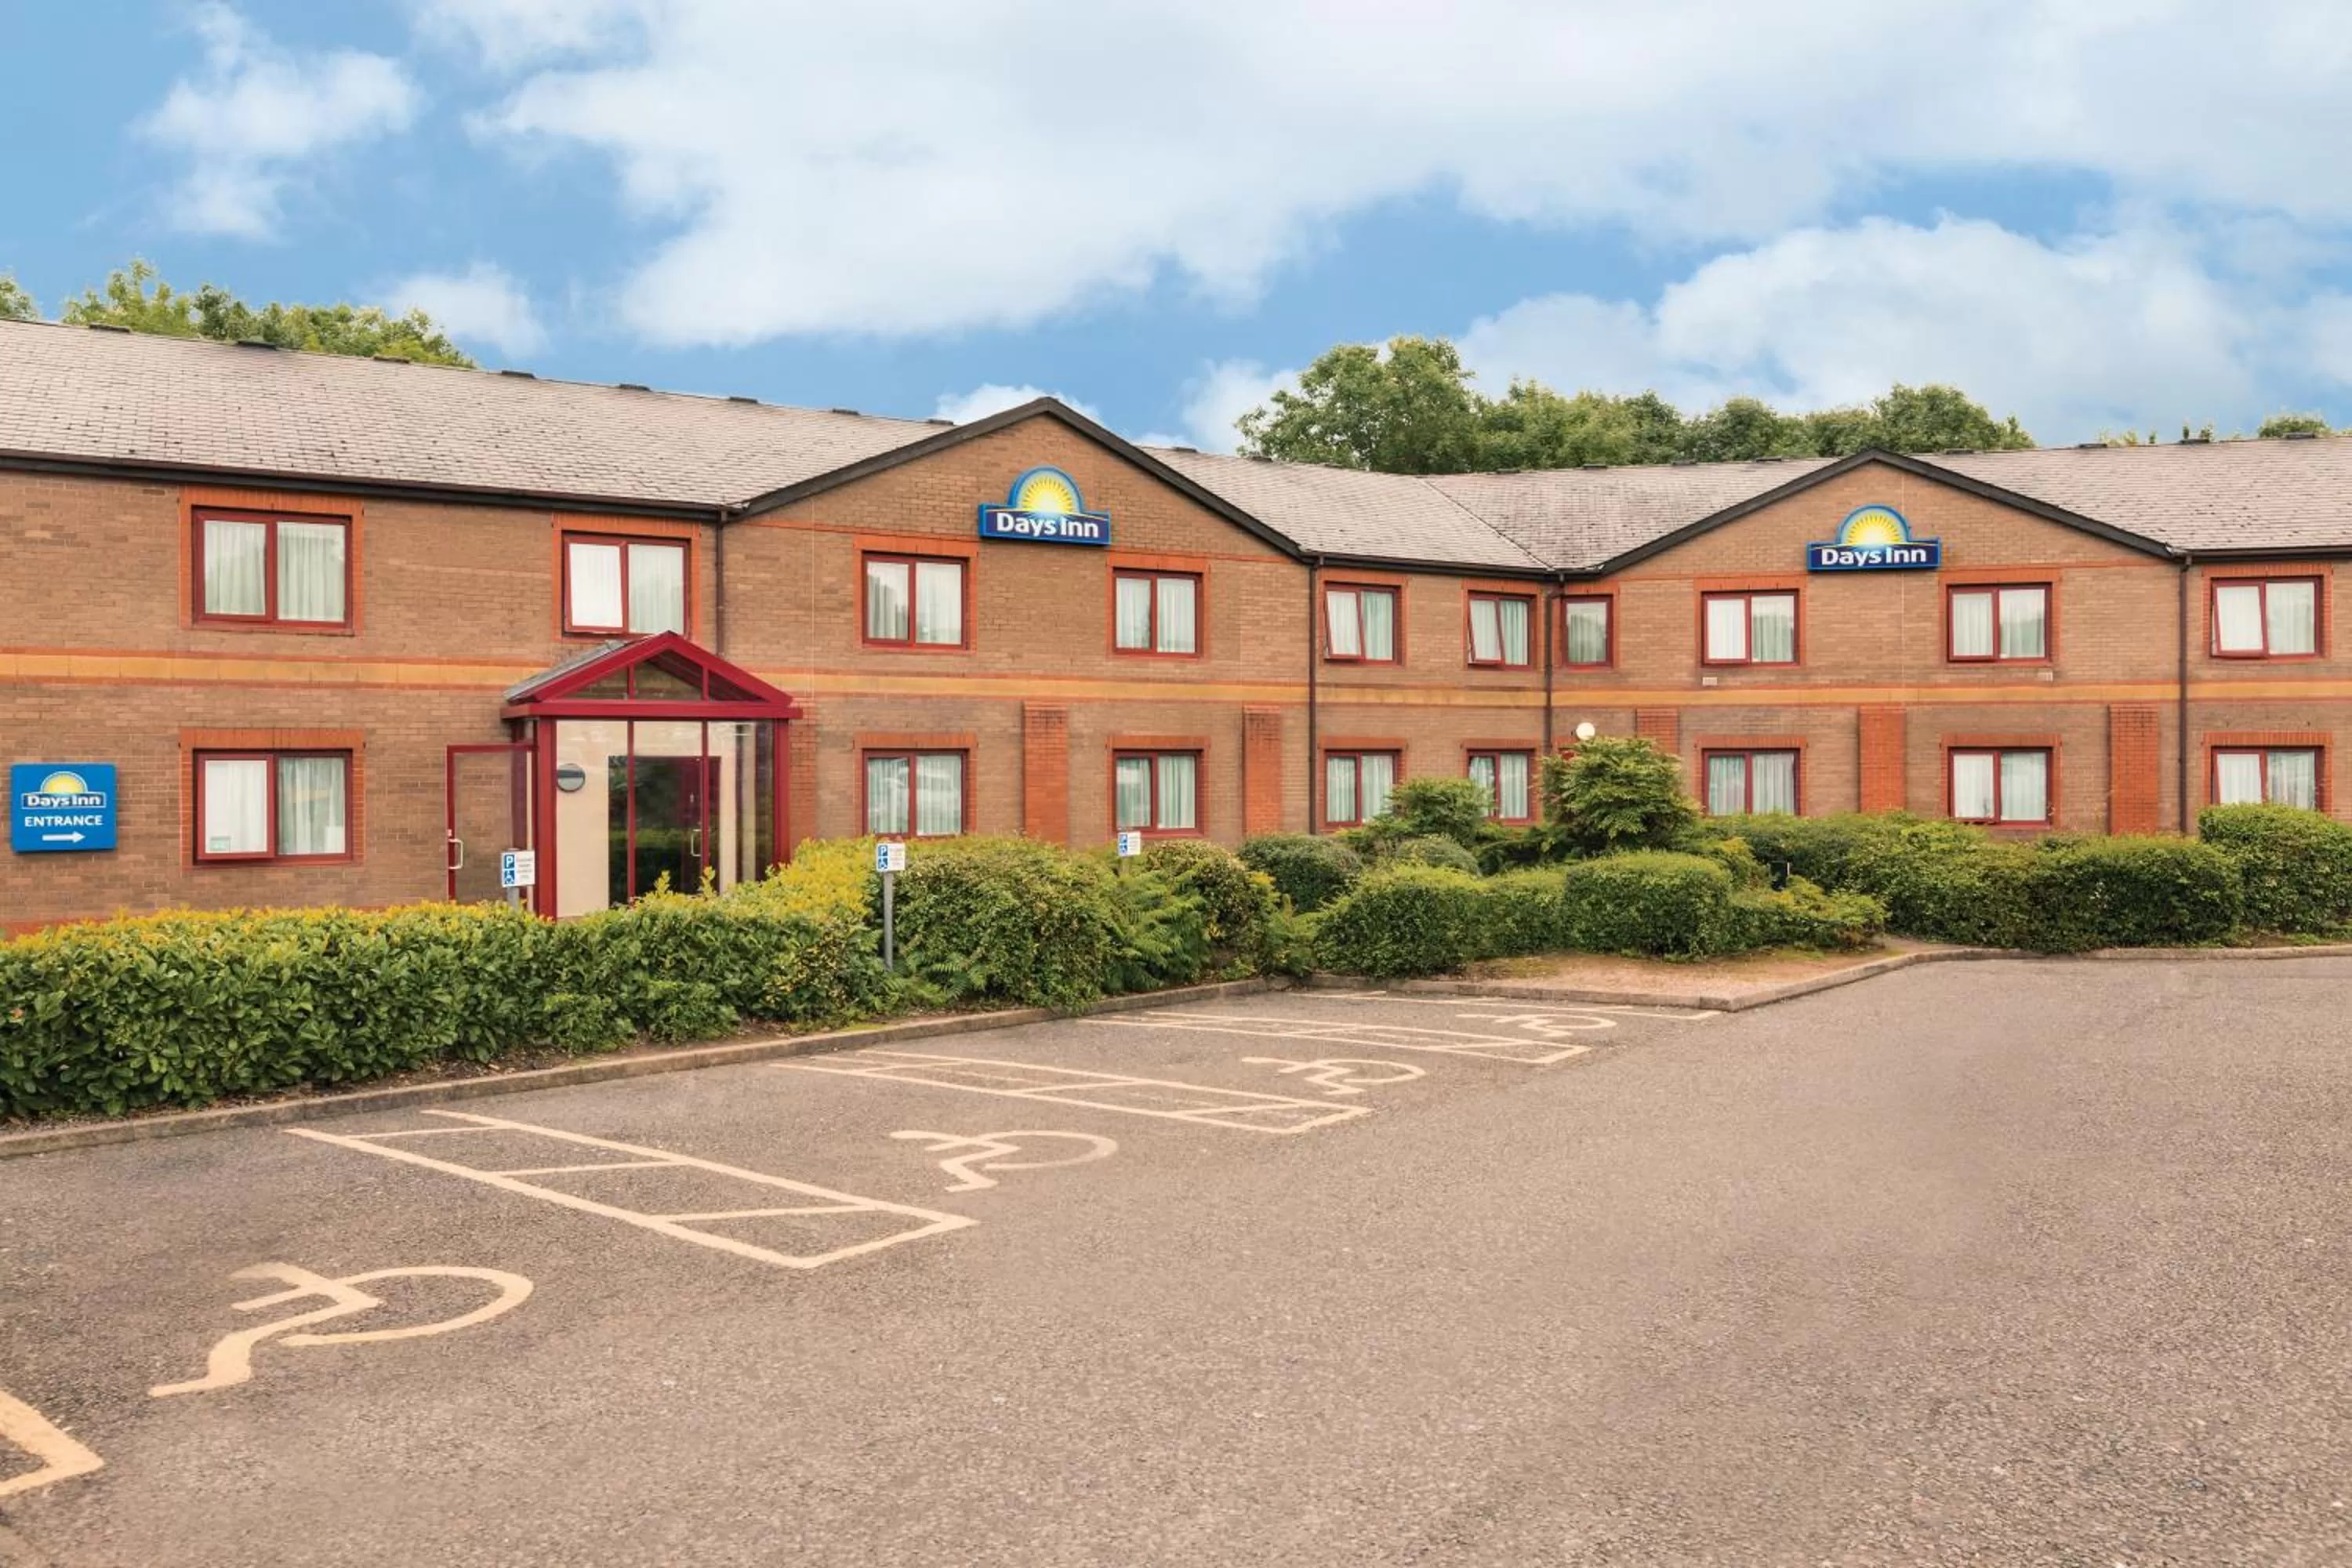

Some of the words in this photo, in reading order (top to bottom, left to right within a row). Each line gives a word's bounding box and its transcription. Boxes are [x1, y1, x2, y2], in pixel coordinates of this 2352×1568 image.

[996, 512, 1057, 536] Days
[1060, 517, 1099, 539] Inn
[1821, 548, 1882, 567] Days
[1886, 547, 1927, 564] Inn
[27, 795, 70, 808] Days
[72, 794, 101, 805] Inn
[24, 815, 103, 827] ENTRANCE
[880, 846, 887, 856] P
[506, 855, 514, 868] P
